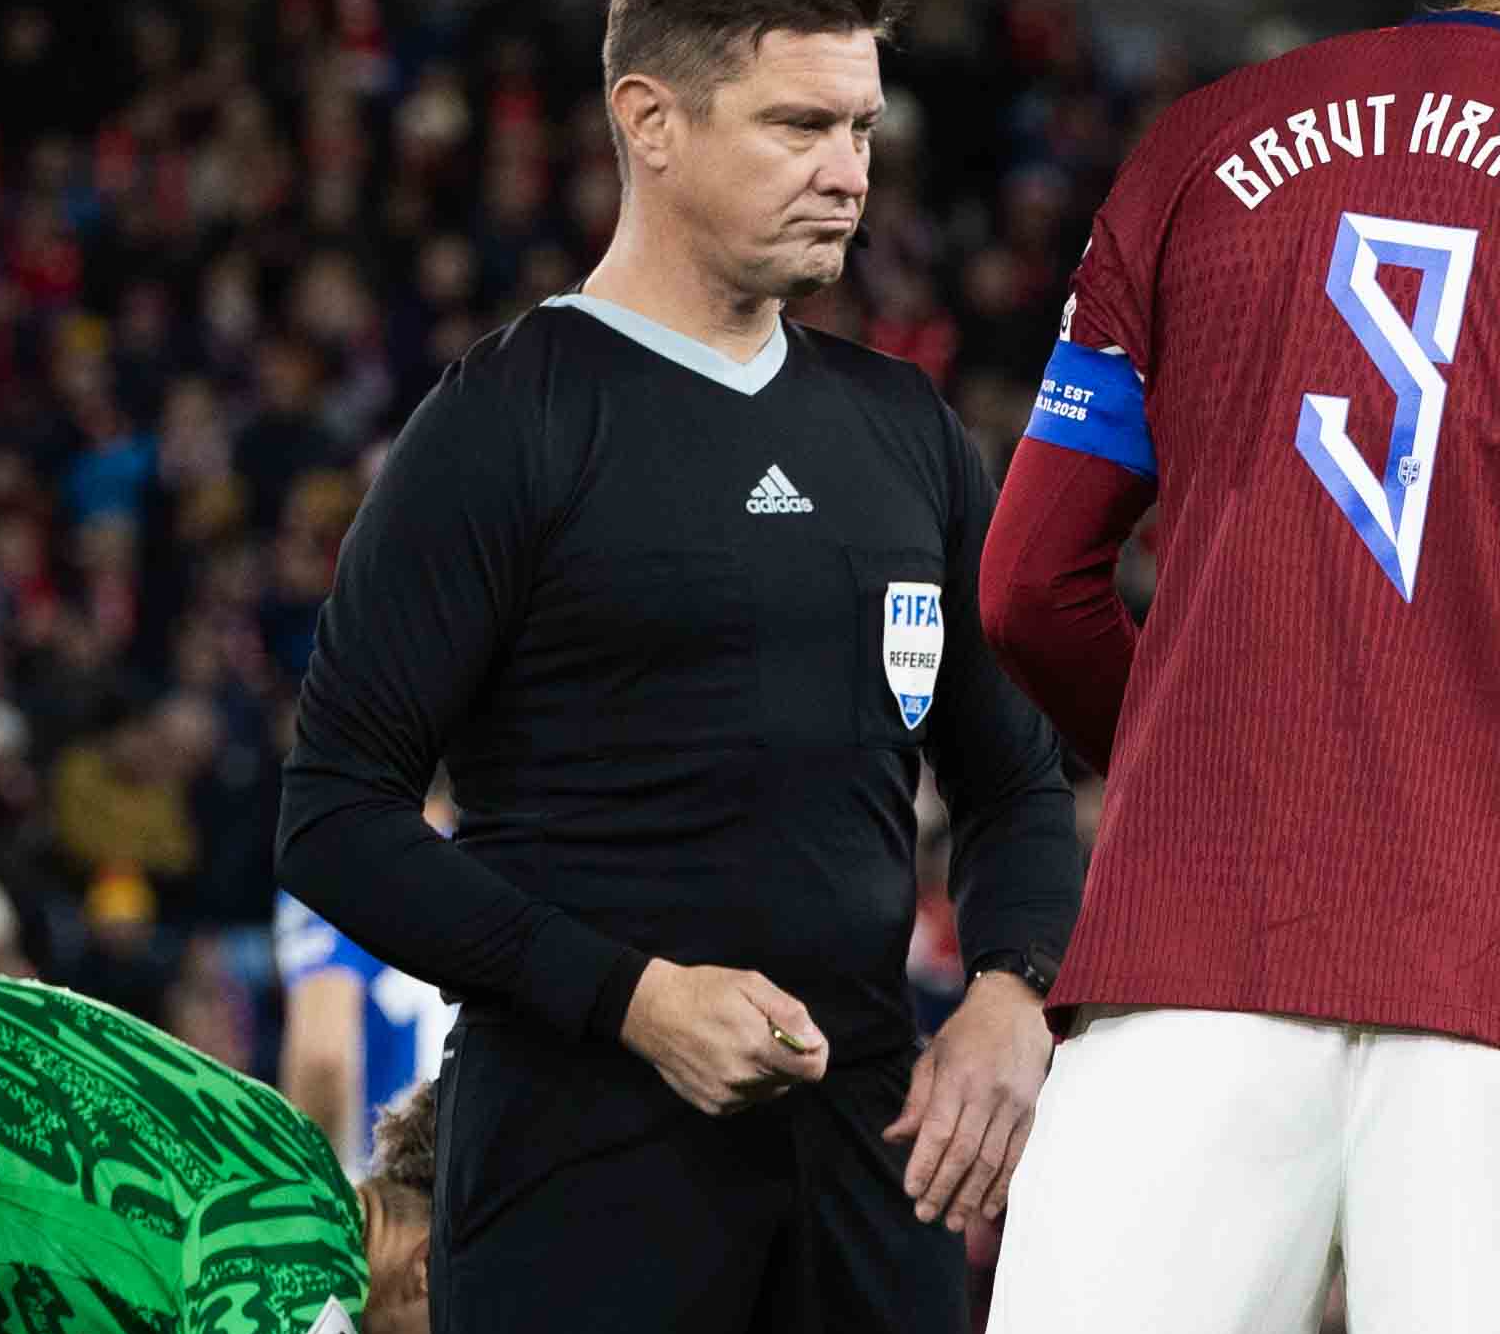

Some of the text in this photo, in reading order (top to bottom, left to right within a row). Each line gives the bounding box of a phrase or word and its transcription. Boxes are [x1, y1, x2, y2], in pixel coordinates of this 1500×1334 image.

[1214, 93, 1396, 211] BRAUT
[1063, 384, 1094, 404] EST
[1294, 211, 1478, 603] 9
[746, 494, 813, 514] adidas
[891, 594, 938, 627] FIFA
[889, 650, 937, 669] REFEREE
